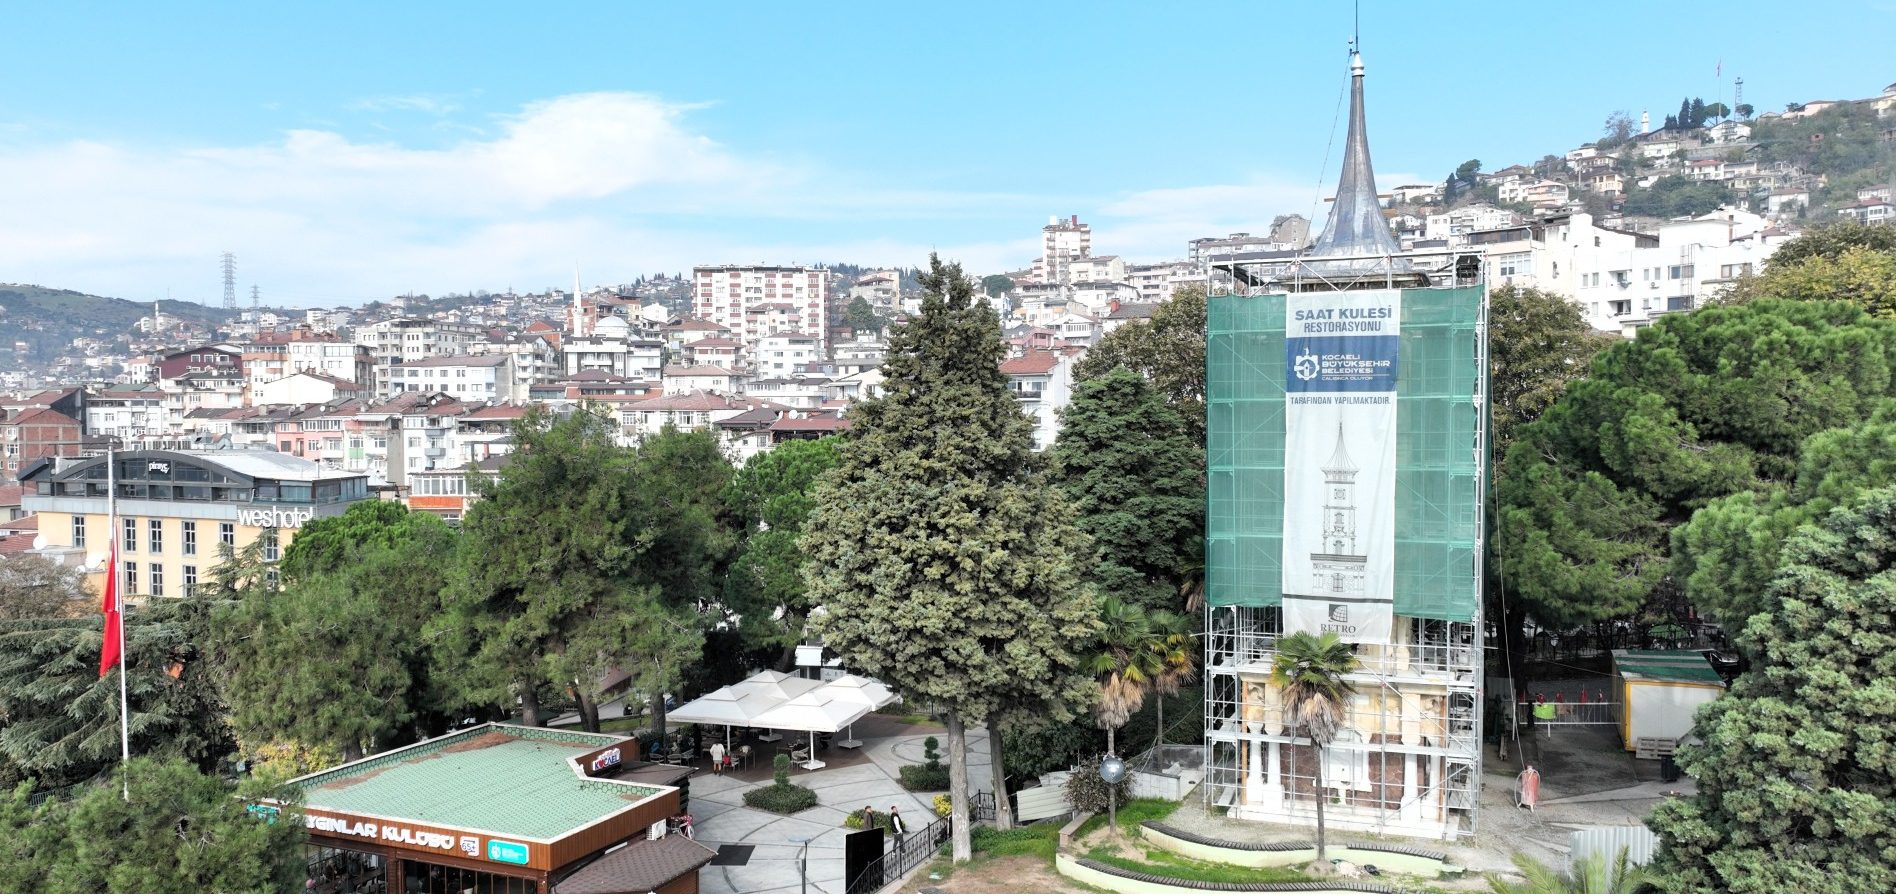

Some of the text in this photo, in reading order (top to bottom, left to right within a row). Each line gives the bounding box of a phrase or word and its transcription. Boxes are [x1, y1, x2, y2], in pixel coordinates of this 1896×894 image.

[1295, 305, 1392, 321] SAAT KULESİ
[1304, 321, 1381, 333] RESTORASYONU
[1291, 397, 1332, 405] TARAFINDAN
[238, 505, 314, 528] weshotel
[1320, 623, 1356, 633] RETRO
[461, 842, 476, 851] 65+
